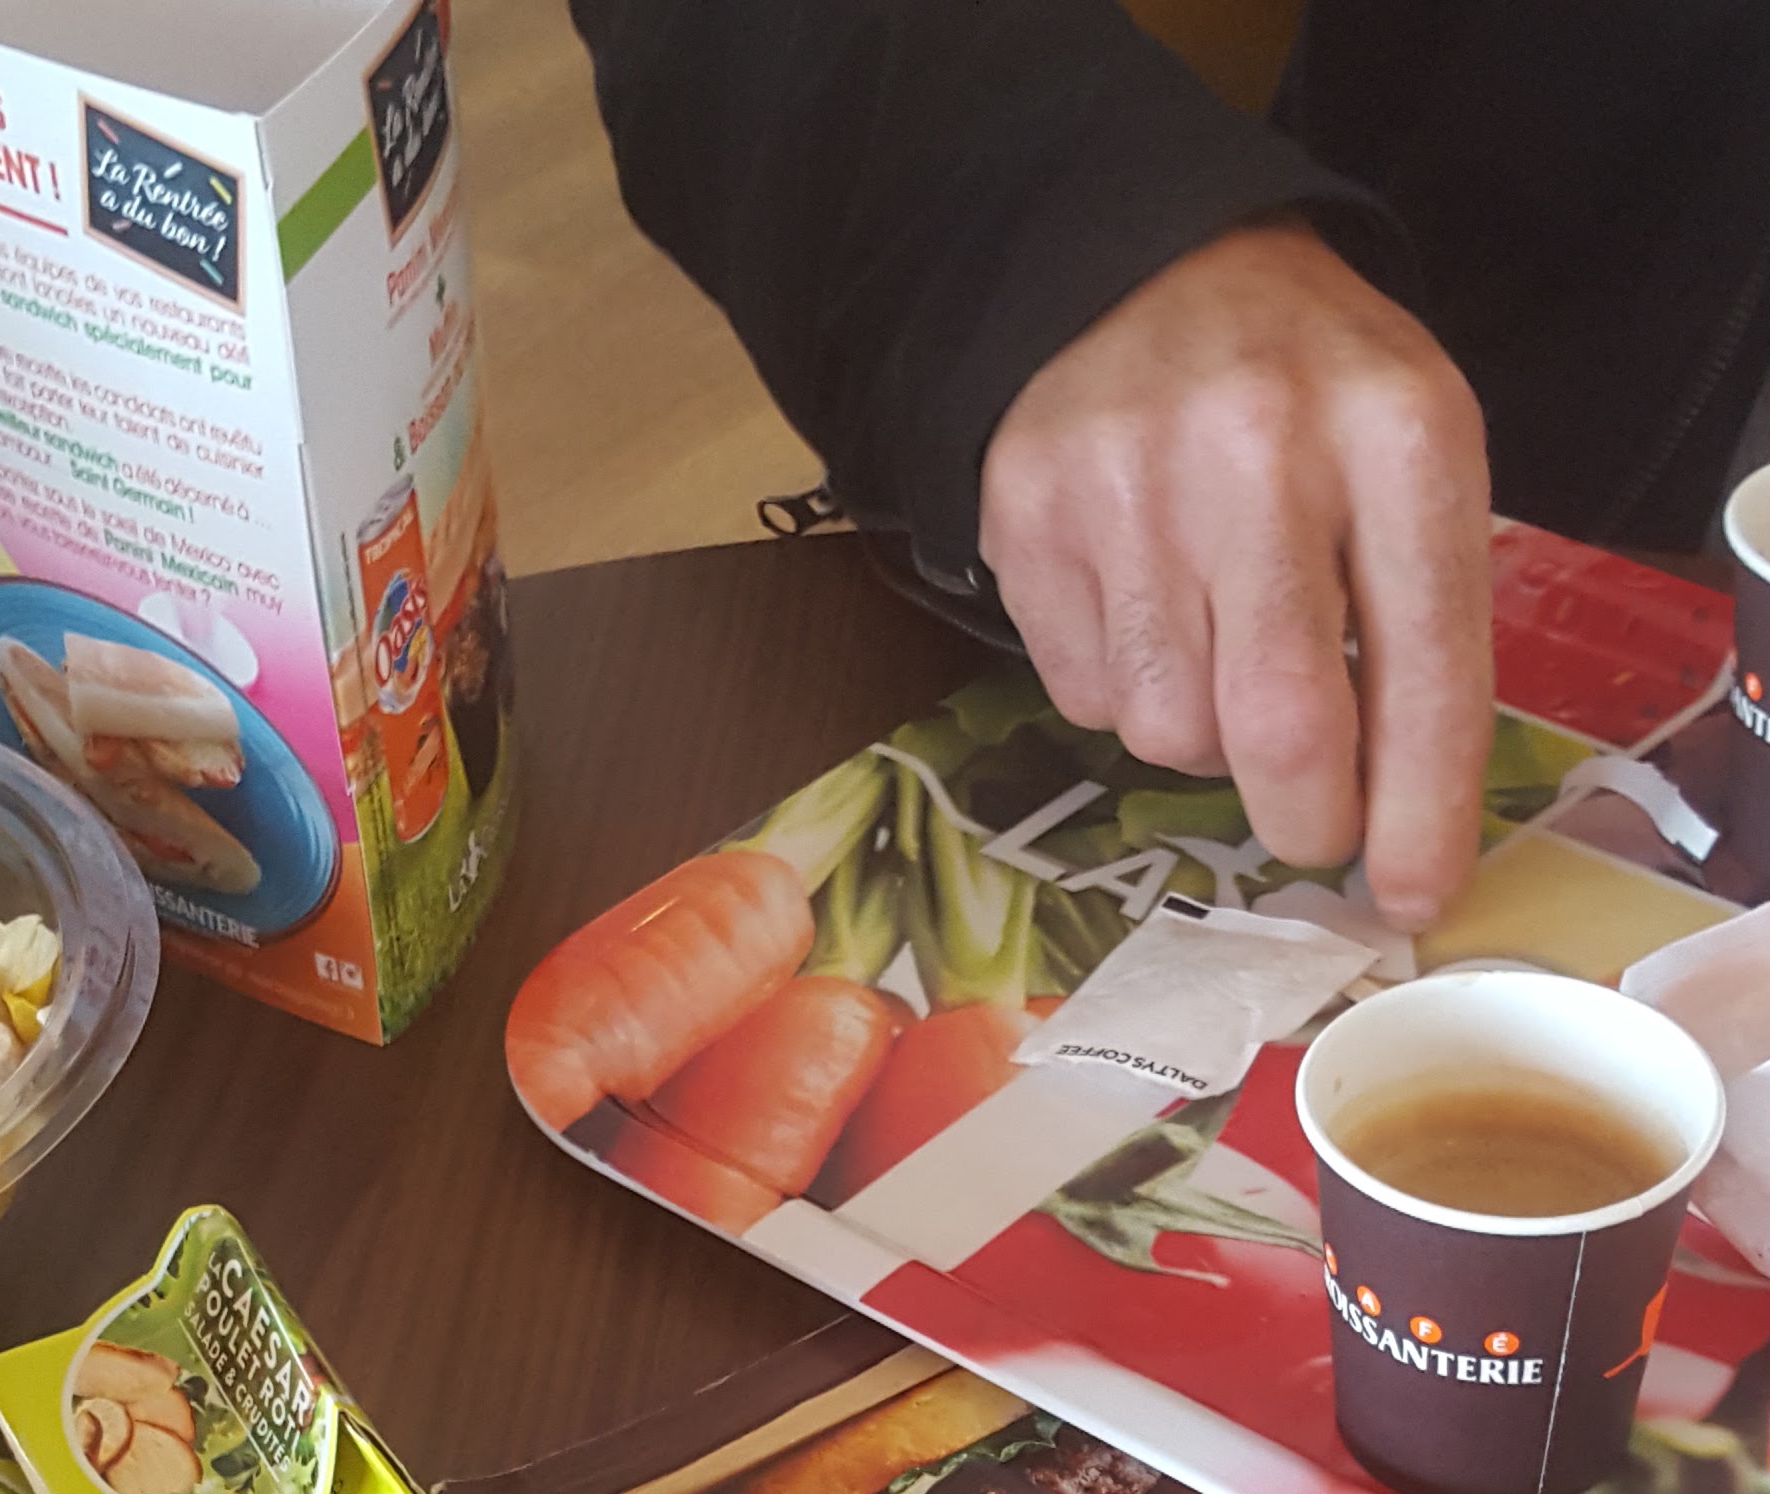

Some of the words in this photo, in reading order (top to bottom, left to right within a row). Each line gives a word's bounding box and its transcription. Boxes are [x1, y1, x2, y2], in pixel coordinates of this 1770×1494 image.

[49, 162, 60, 200] !
[91, 149, 129, 185] La
[132, 163, 229, 231] Rentrée
[100, 190, 118, 211] a
[122, 196, 156, 229] du
[161, 211, 210, 254] bon
[212, 235, 226, 262] !
[83, 268, 108, 297] de
[113, 281, 142, 310] vos
[83, 318, 204, 379] spécialement
[209, 363, 254, 395] pour
[103, 304, 125, 327] un
[131, 313, 211, 358] nouveau
[78, 396, 109, 425] leur
[113, 409, 161, 447] talent
[165, 431, 190, 457] de
[195, 441, 266, 483] cuisinier
[92, 378, 176, 430] candidats
[177, 409, 206, 439] ont
[42, 427, 118, 475] sandwich
[69, 457, 109, 492] Saint
[111, 475, 186, 524] Germain
[102, 526, 154, 566] Panini
[159, 550, 239, 600] Mexicain
[142, 523, 167, 550] de
[170, 532, 232, 576] Mexico
[236, 558, 281, 592] avec
[195, 1272, 260, 1381] POULET
[258, 1377, 302, 1456] RÔTI
[209, 1252, 222, 1279] LA
[222, 1259, 311, 1425] CAESAR
[184, 1302, 228, 1371] SALADE
[224, 1366, 236, 1386] &
[235, 1383, 292, 1474] CRUDITÉS
